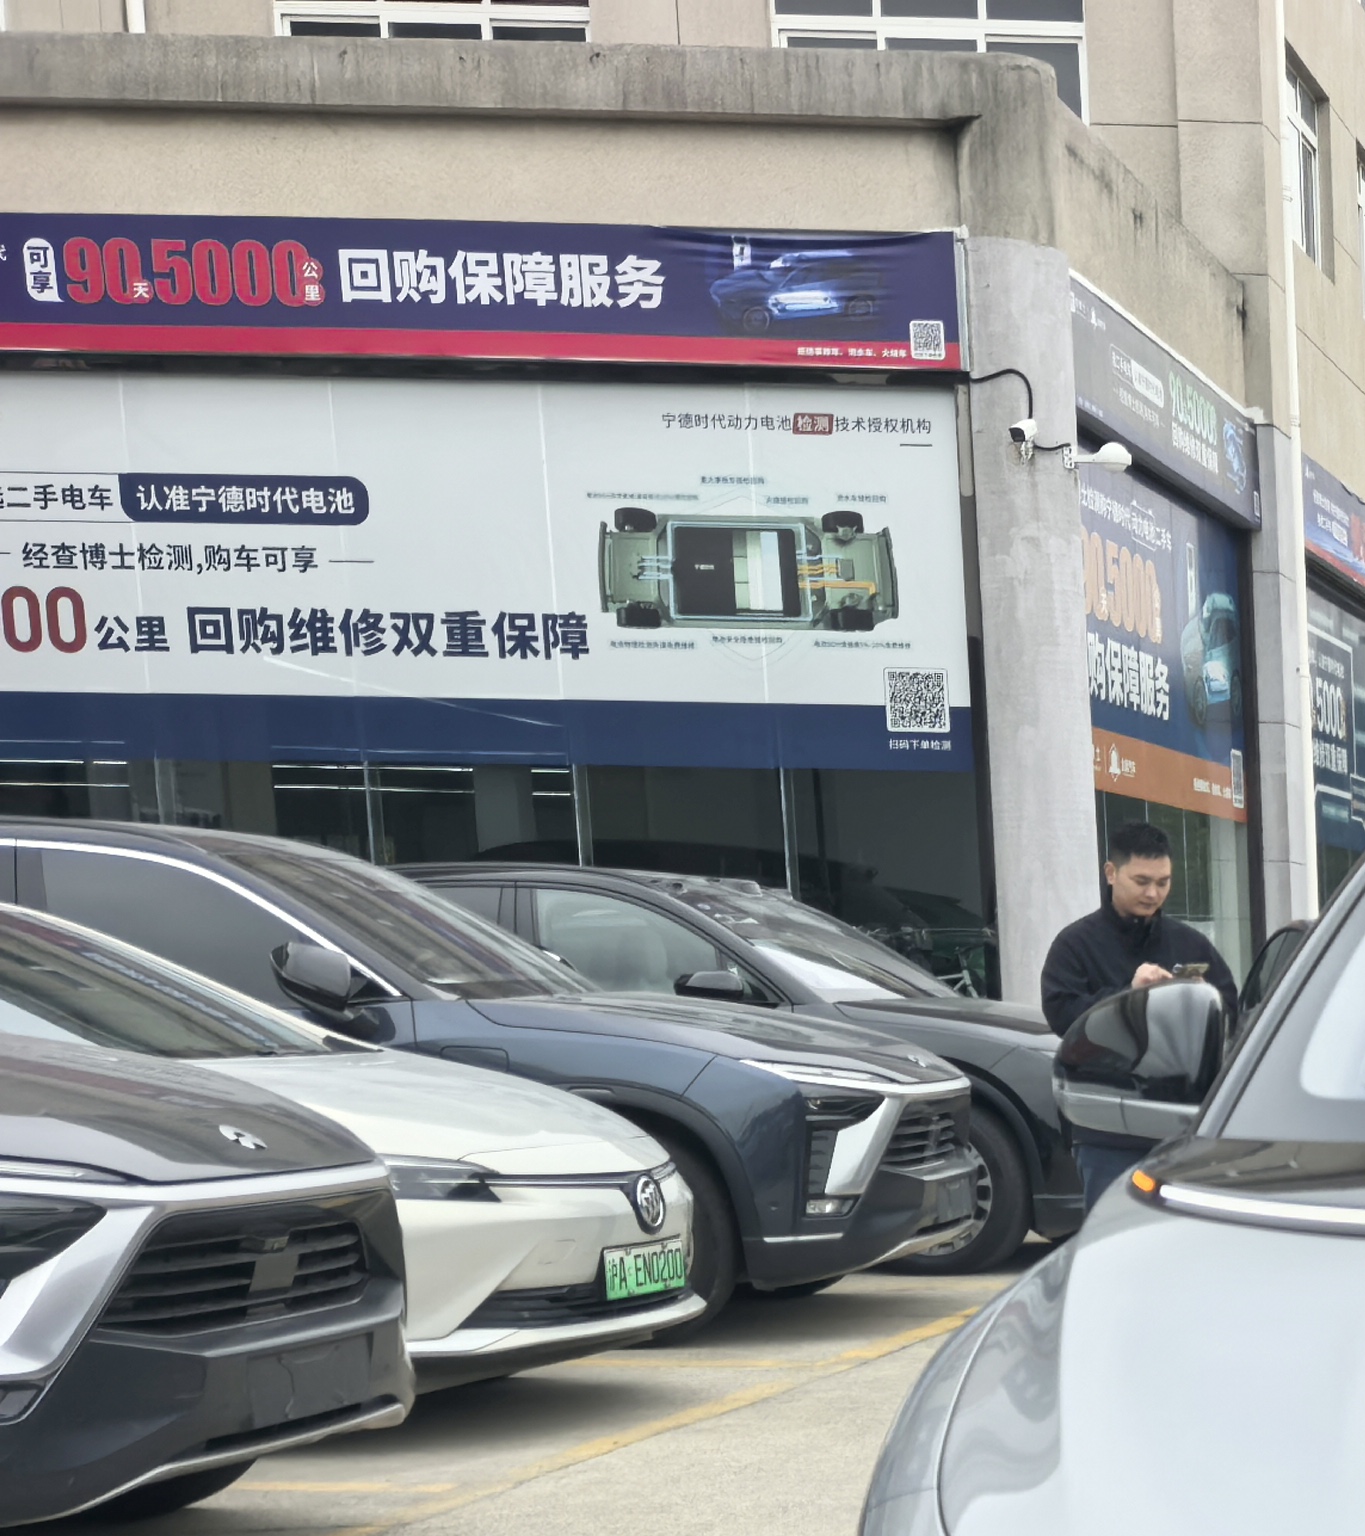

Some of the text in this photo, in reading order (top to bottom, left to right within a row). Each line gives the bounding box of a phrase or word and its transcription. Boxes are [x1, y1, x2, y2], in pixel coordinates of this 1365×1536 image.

[27, 245, 53, 293] 可享
[151, 238, 311, 306] 5000
[302, 260, 322, 302] 公里
[337, 248, 666, 309] 回购保障服务
[0, 483, 356, 516] 二手电车 认准宁德时代电池
[94, 615, 171, 653] 公里
[186, 605, 590, 660] 回购维修双重保障
